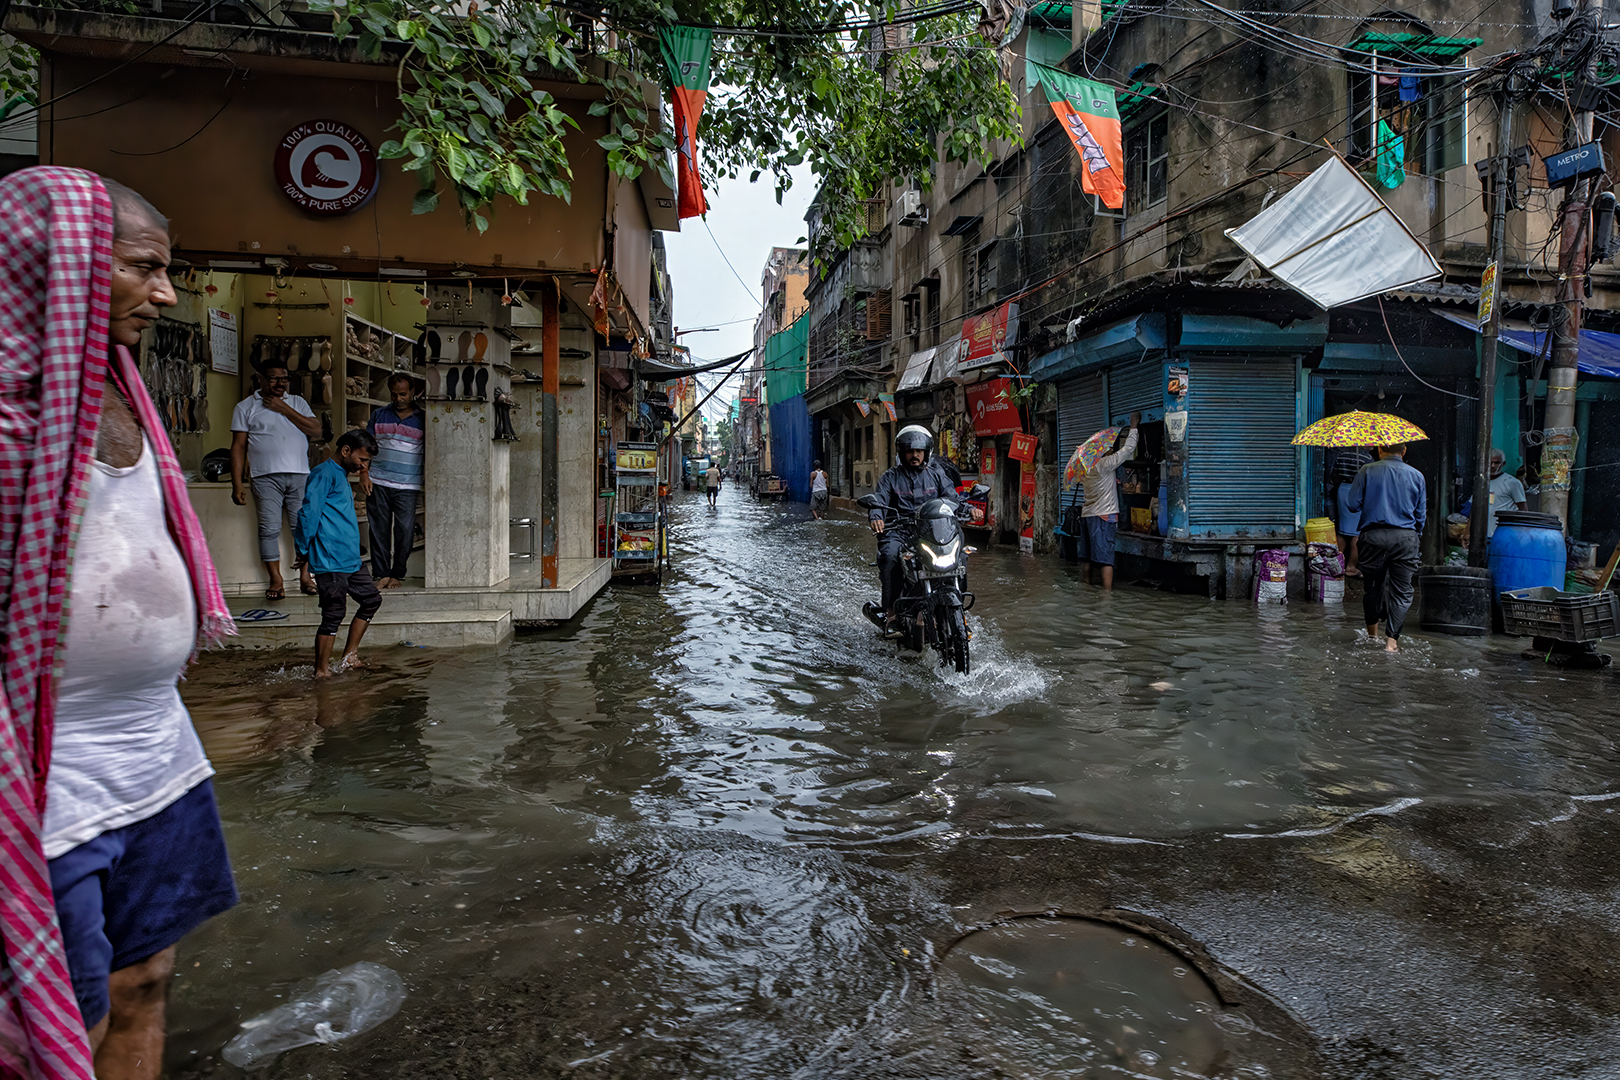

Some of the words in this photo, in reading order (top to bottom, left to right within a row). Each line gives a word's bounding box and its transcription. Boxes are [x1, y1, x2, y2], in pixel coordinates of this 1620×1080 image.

[282, 125, 312, 150] 100%
[315, 122, 370, 153] QUALITY
[1557, 150, 1590, 167] METRO
[283, 182, 307, 206] 100%
[308, 199, 342, 211] PURE
[341, 185, 369, 207] SOLE
